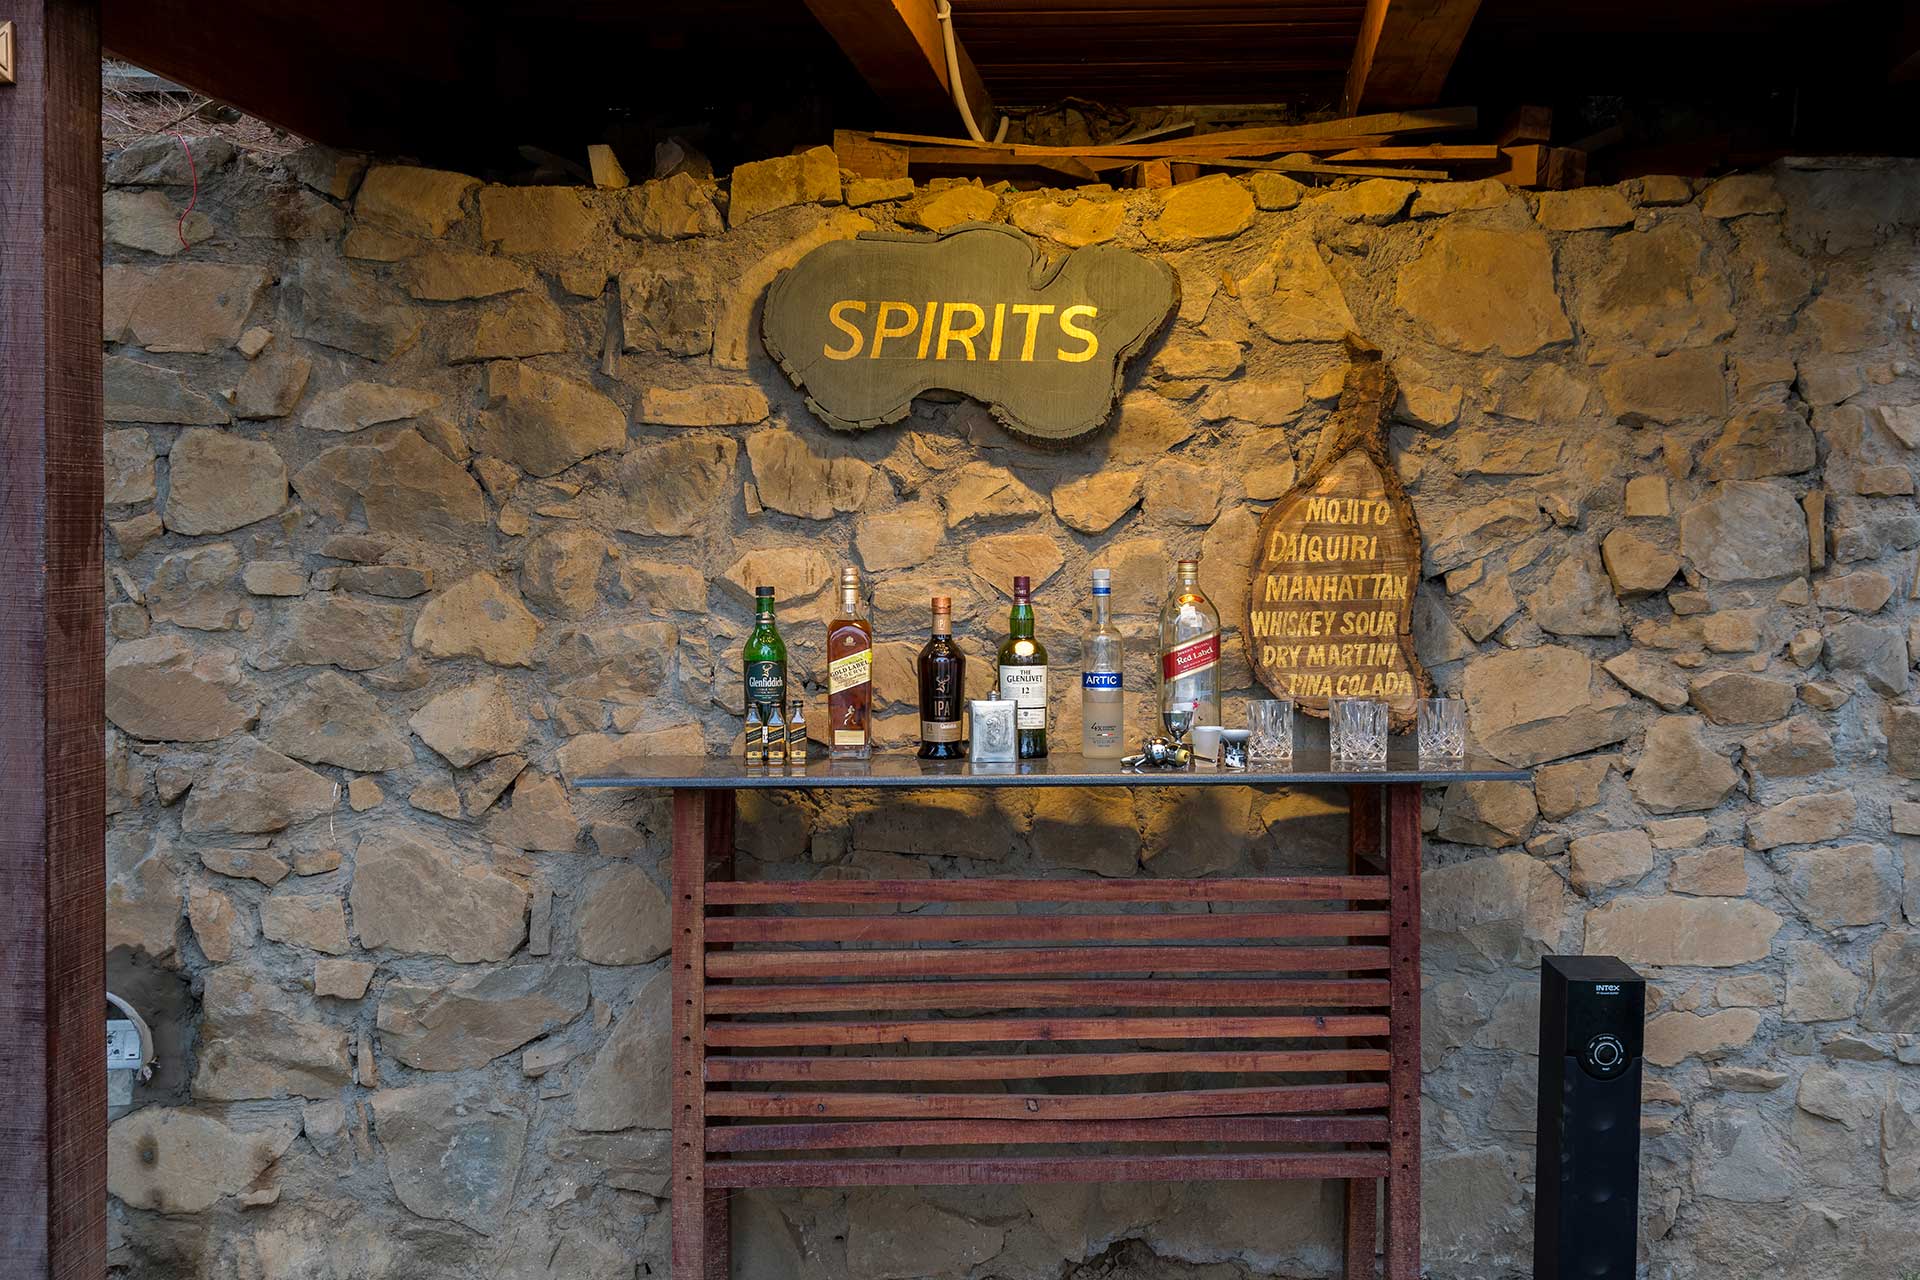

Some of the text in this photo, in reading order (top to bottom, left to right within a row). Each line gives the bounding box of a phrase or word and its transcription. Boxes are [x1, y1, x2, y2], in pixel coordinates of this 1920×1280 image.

[823, 300, 1099, 363] SPIRITS
[1305, 498, 1391, 524] MOJITO
[1269, 531, 1377, 562] DAIQUIRI
[1265, 574, 1408, 602] MANHATTAN
[1250, 611, 1397, 637] WHISKEY SOUR
[1176, 654, 1193, 666] Red
[1192, 645, 1214, 660] Label
[1262, 643, 1398, 668] DRY MARTINI
[749, 676, 784, 688] Glenfiddich
[1006, 674, 1043, 683] GLENLIVET
[1085, 675, 1118, 685] ARTIC
[1336, 671, 1414, 697] COLADA
[934, 700, 950, 716] IPA
